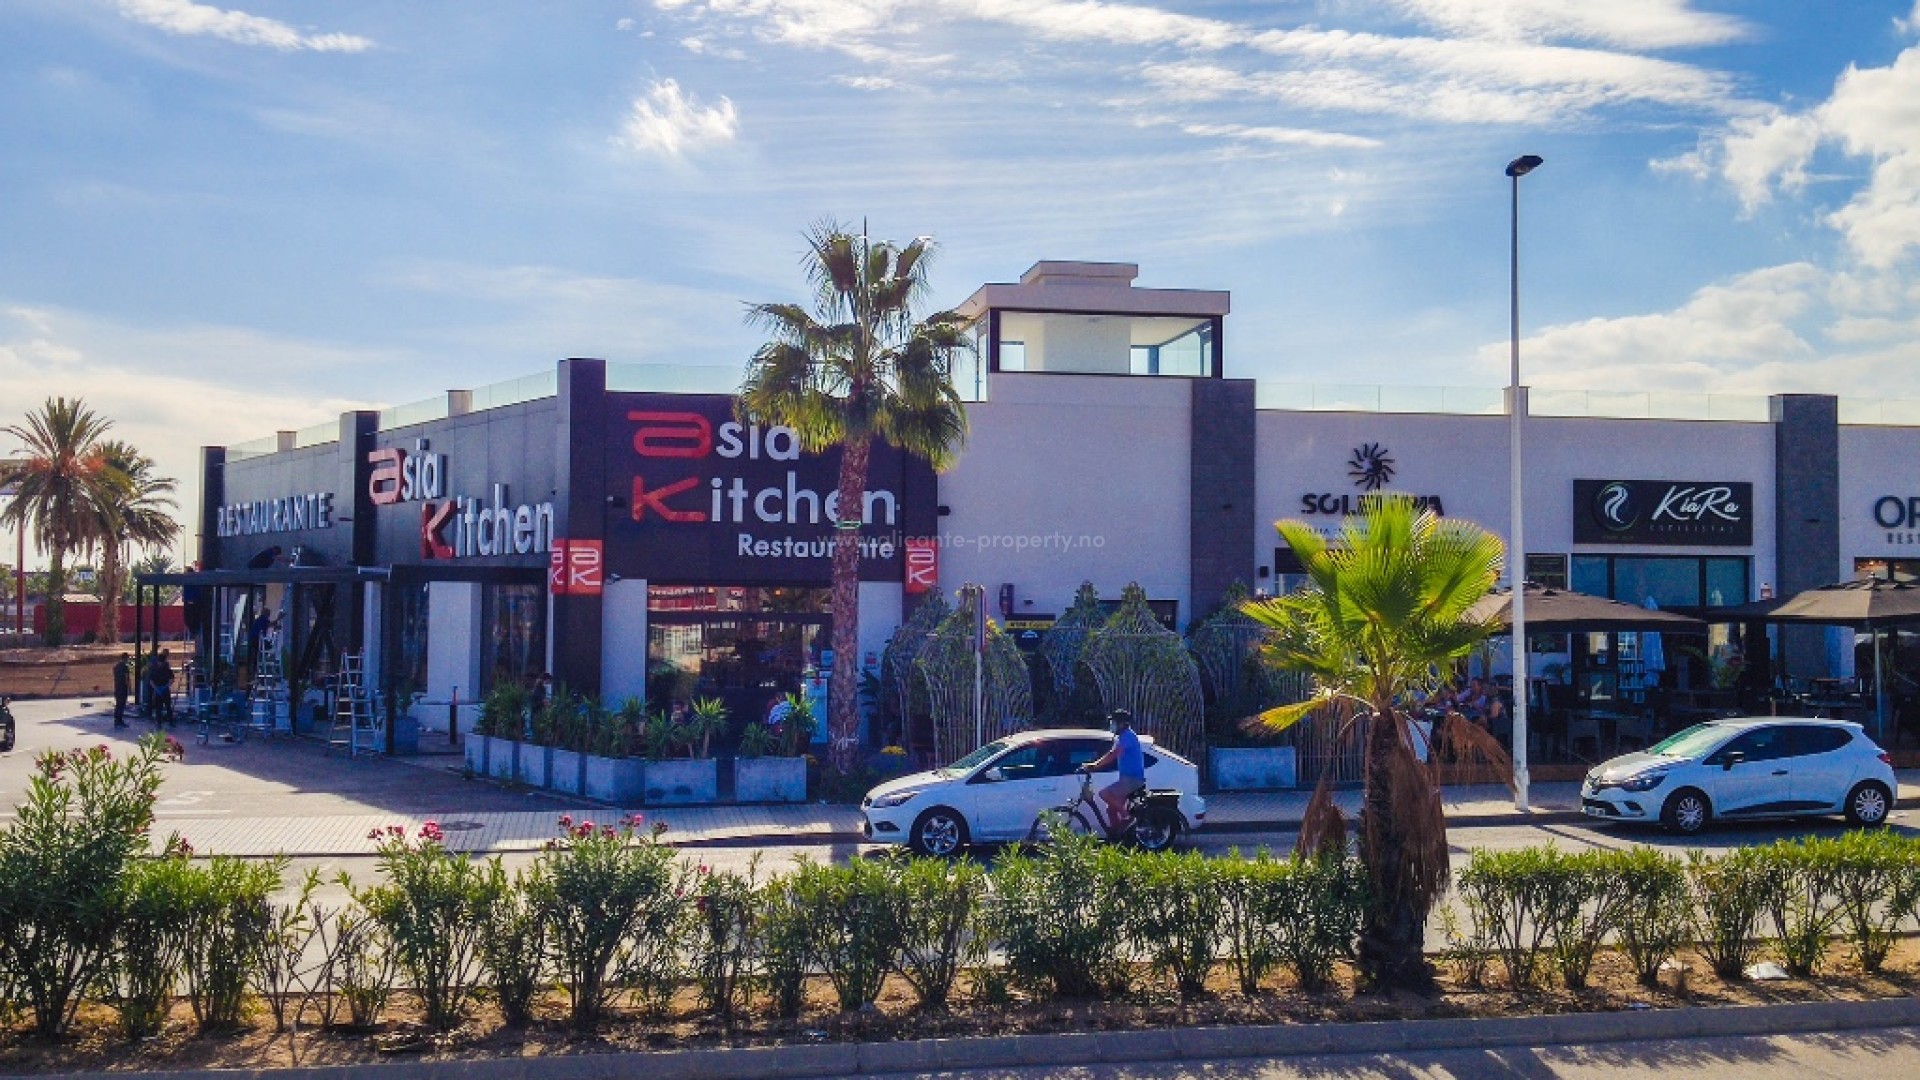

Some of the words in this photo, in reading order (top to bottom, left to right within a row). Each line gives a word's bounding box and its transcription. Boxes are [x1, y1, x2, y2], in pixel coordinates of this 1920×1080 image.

[217, 492, 332, 537] RESTAURANTE
[421, 482, 554, 560] Kitchen
[738, 533, 895, 559] Restaurnte
[1887, 532, 1920, 545] RES
